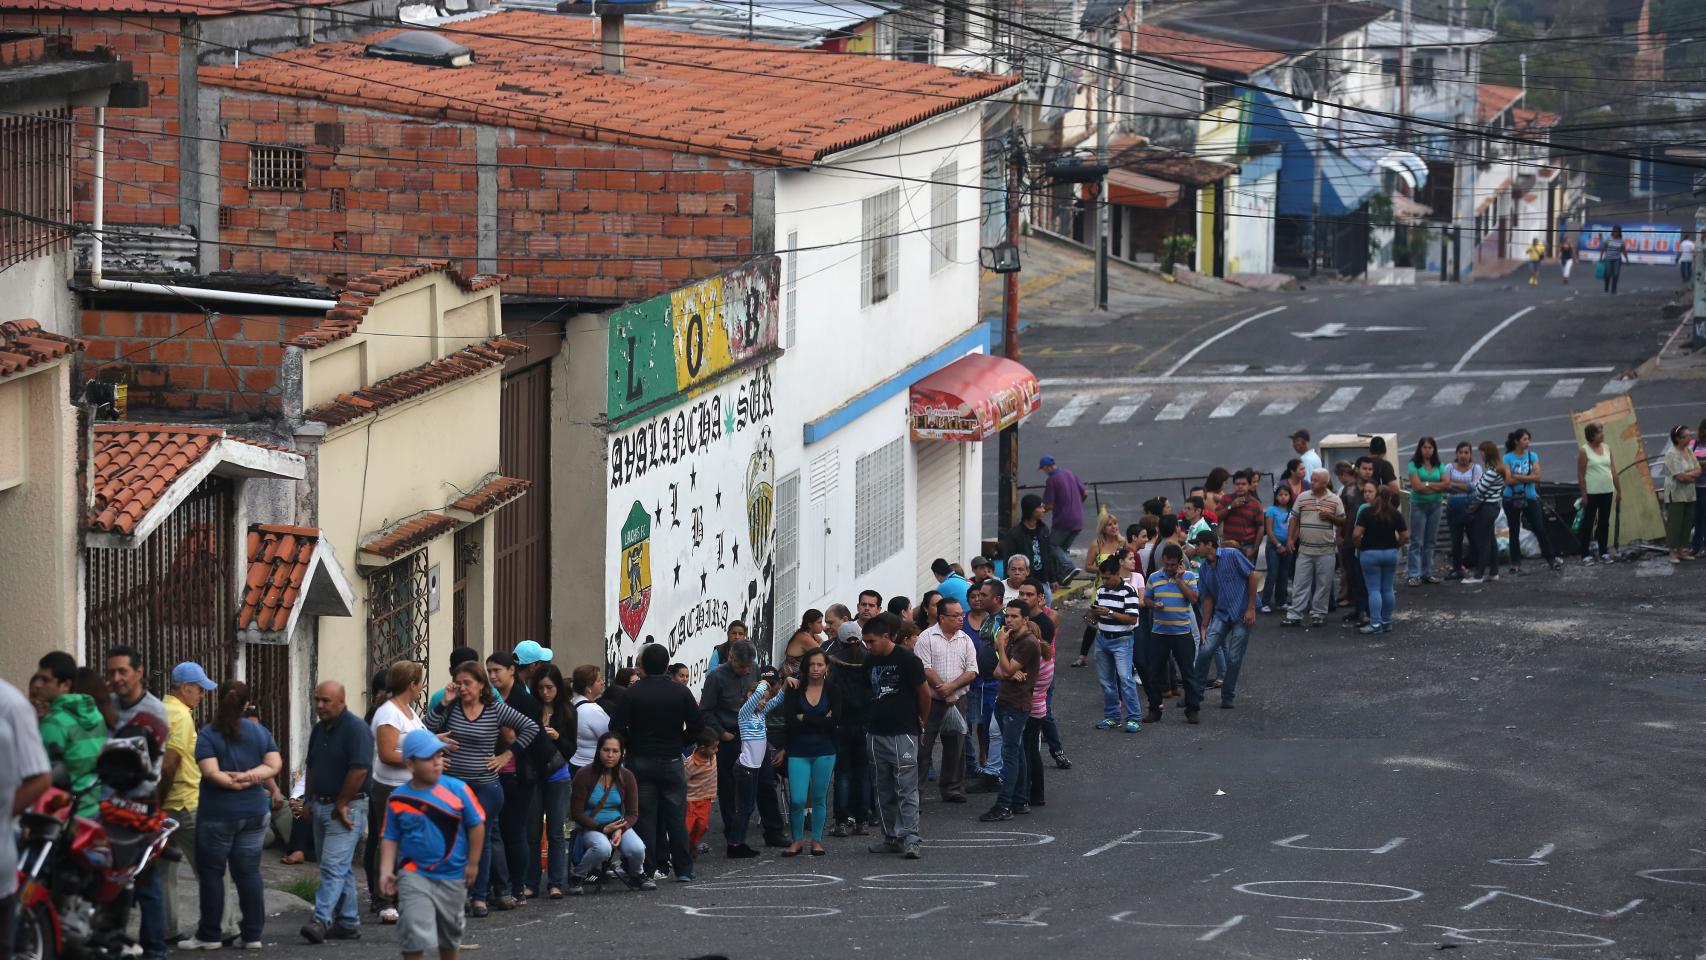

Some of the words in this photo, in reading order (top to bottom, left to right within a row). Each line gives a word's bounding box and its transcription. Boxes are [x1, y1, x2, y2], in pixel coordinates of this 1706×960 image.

[611, 394, 722, 490] AVALANCHA
[736, 369, 774, 432] SUR
[667, 598, 729, 658] TACHIRA
